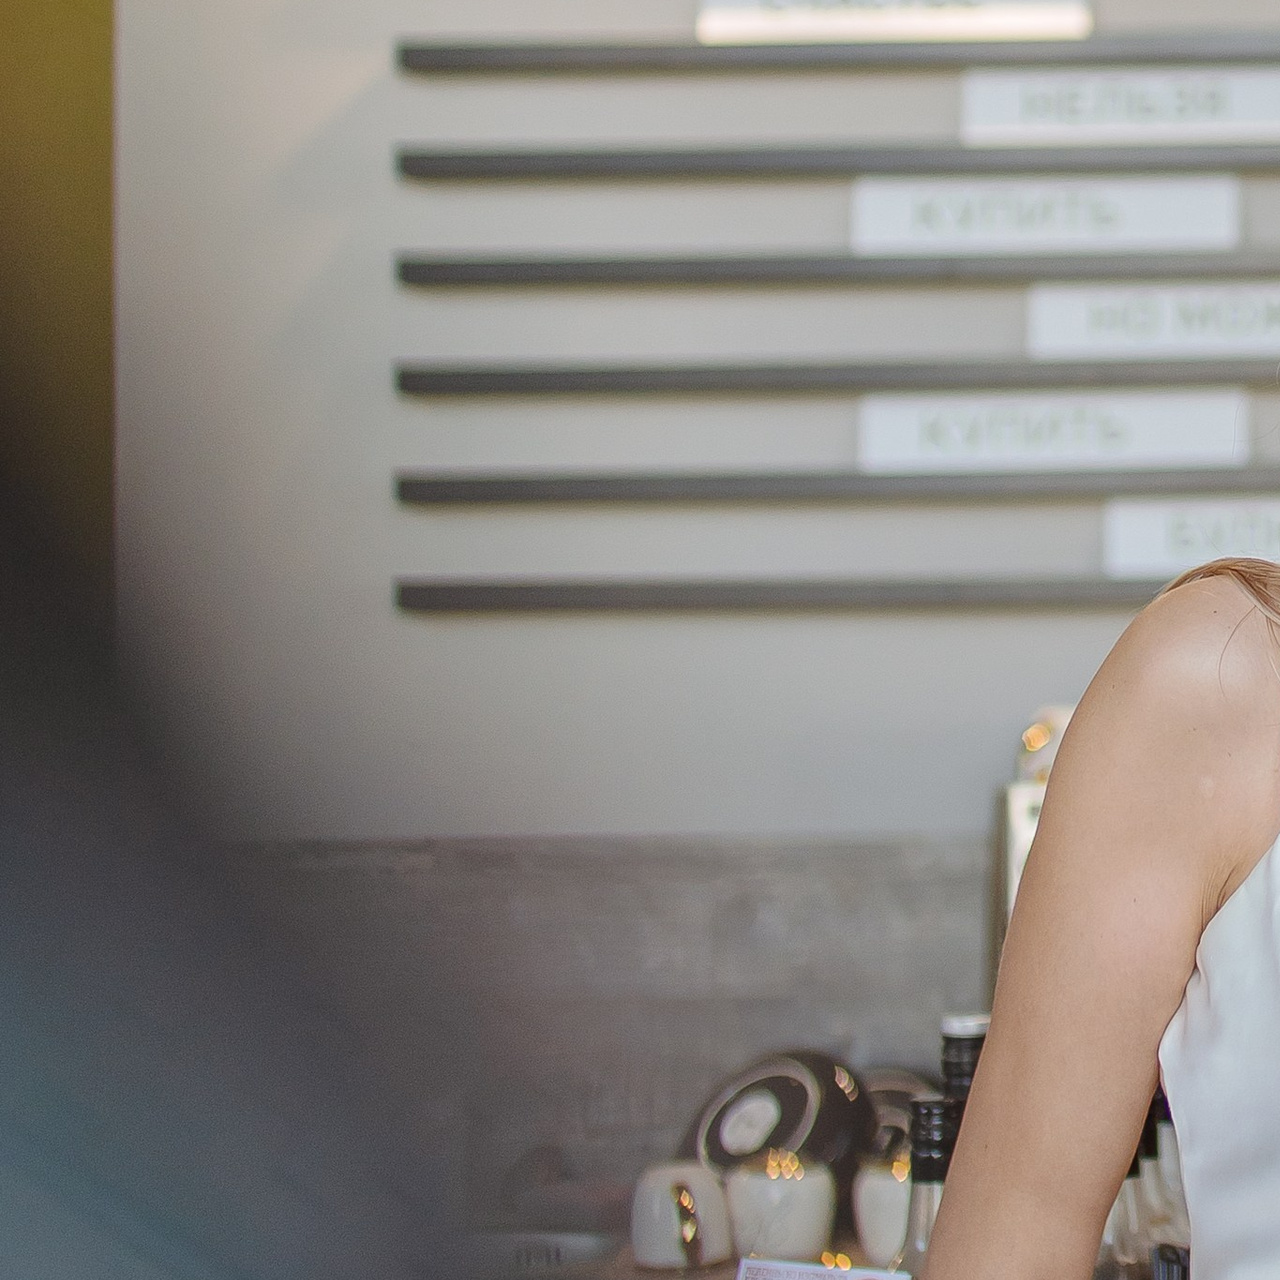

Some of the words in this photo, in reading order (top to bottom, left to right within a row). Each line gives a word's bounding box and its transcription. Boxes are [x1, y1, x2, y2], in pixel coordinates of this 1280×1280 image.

[1019, 81, 1232, 122] НЕЛЬЗЯ
[911, 191, 1122, 232] КУПИТЬ
[919, 406, 1131, 448] КУПИТЬ
